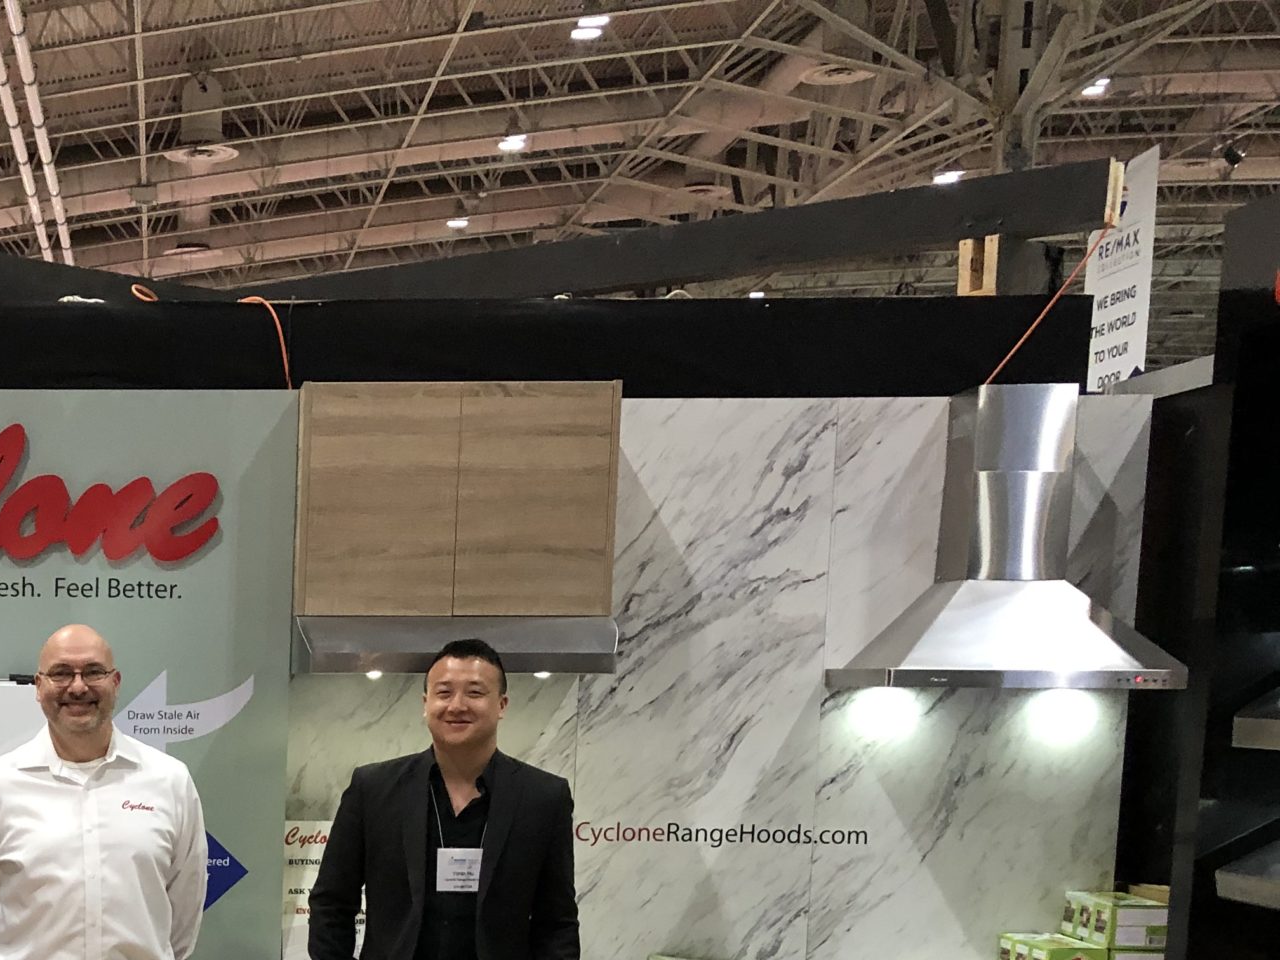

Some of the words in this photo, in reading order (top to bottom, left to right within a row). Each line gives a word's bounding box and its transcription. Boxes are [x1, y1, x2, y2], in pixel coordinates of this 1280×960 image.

[1098, 227, 1141, 261] RE/MAX
[1096, 295, 1109, 312] WE
[1110, 284, 1137, 308] BRING
[1090, 320, 1106, 339] THE
[1106, 311, 1137, 335] WORLD
[1094, 350, 1106, 364] TO
[1106, 341, 1129, 362] YOUR
[54, 577, 100, 598] Feel
[108, 578, 182, 599] Better.
[127, 710, 155, 720] Draw
[157, 710, 182, 720] Stale
[185, 711, 200, 720] Air
[133, 726, 160, 735] From
[163, 726, 195, 735] Inside
[122, 800, 155, 811] Cyclone
[285, 826, 328, 848] Cyclo
[575, 821, 869, 849] CycloneRangeHoods.com
[206, 856, 230, 866] ered
